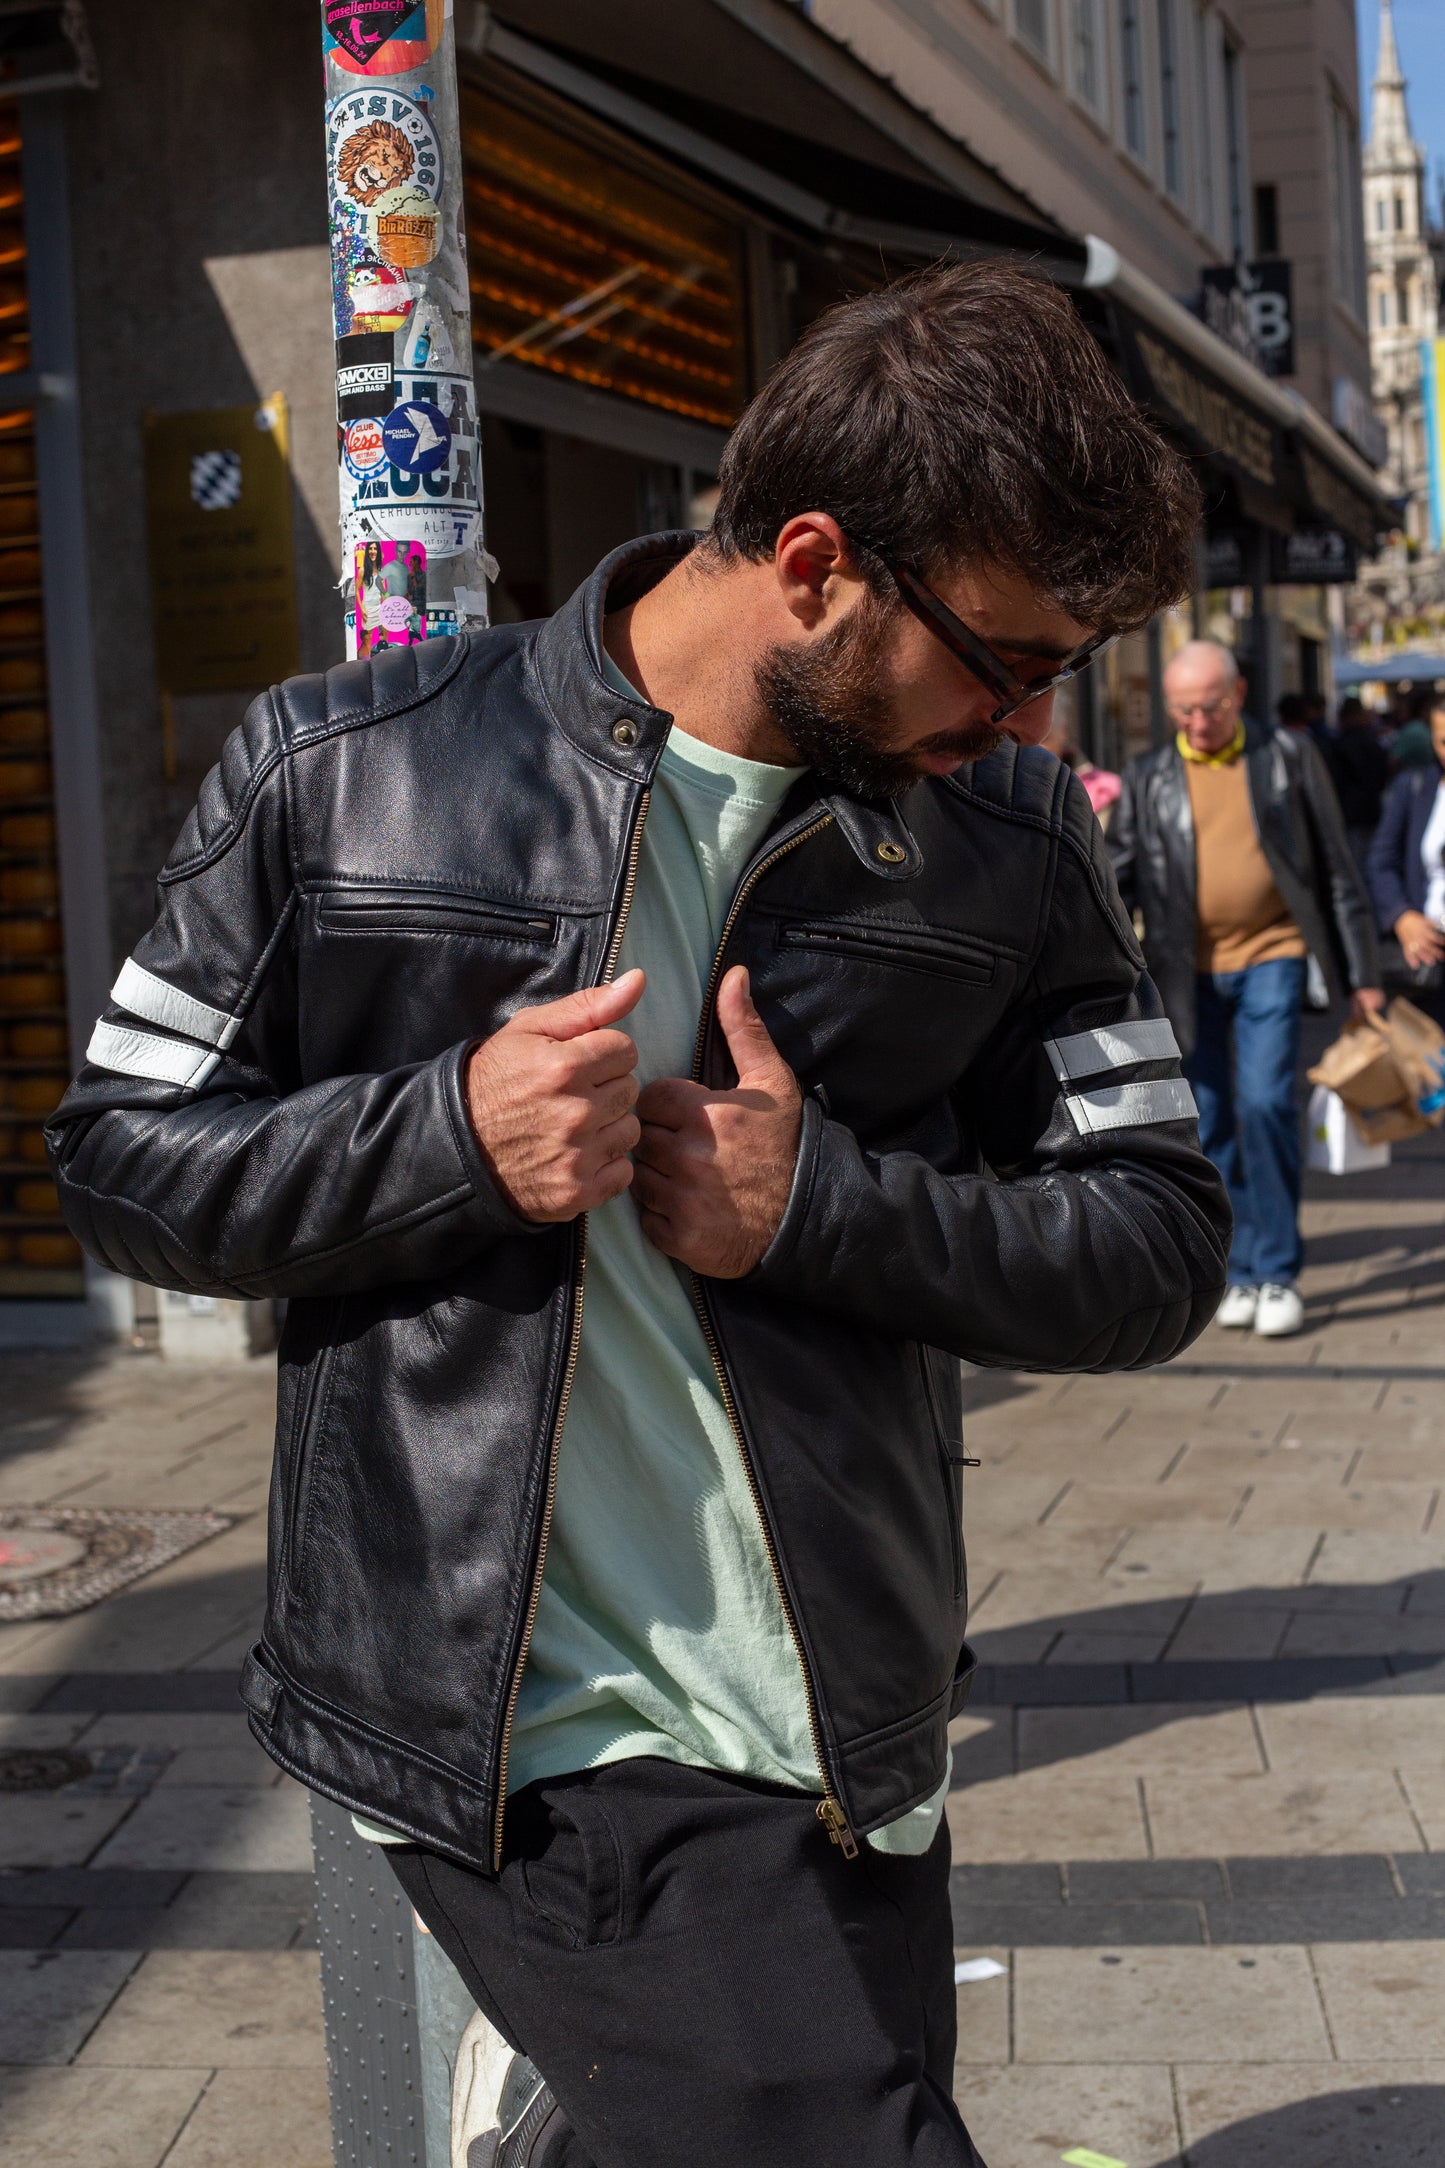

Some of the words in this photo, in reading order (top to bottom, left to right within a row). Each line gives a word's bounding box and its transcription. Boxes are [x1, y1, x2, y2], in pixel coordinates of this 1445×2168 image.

[348, 96, 413, 122] TSV
[367, 255, 405, 284] ЭКСПЕДИЦ
[340, 388, 351, 397] DRUM
[352, 386, 365, 394] AND
[365, 384, 386, 392] BASS
[356, 423, 374, 432] CLUB
[346, 426, 383, 454] Vesp
[424, 521, 446, 533] ALT
